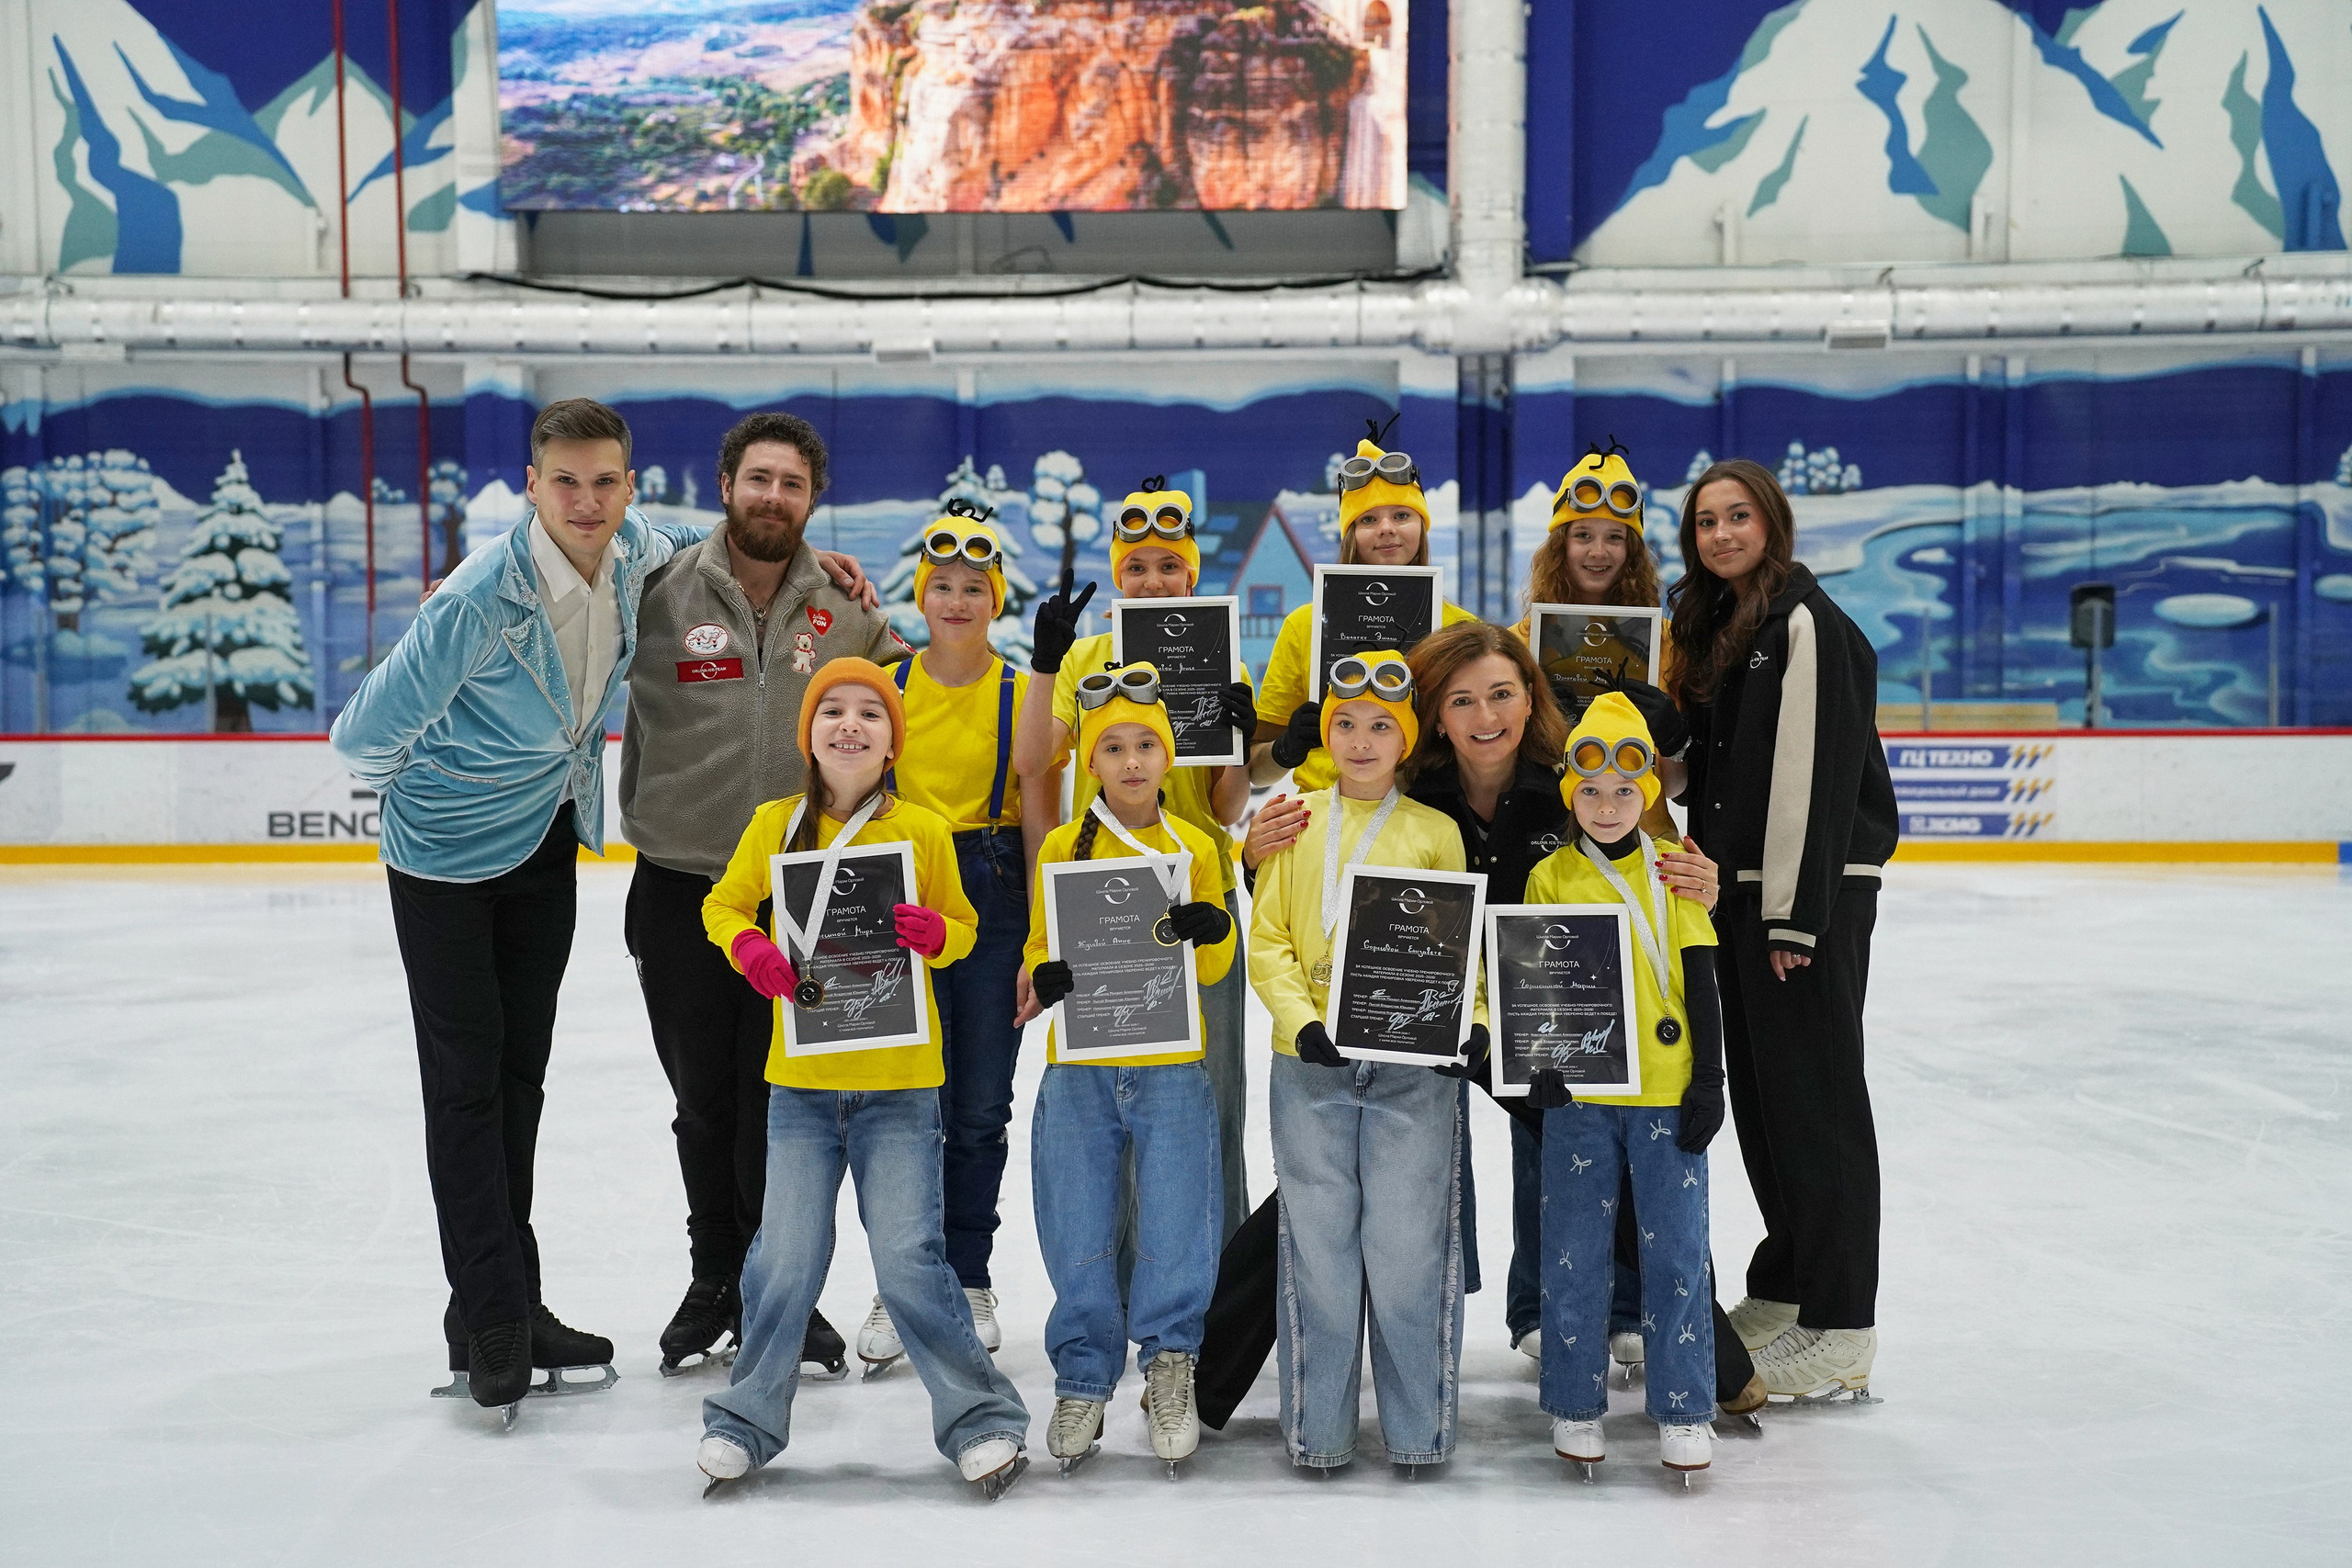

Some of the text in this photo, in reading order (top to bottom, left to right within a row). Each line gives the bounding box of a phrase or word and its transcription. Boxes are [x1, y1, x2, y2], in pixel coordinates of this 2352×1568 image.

[1576, 656, 1612, 664] ГРАМОТА
[1928, 749, 1995, 767] ТЕХНО
[826, 905, 866, 916] ГРАМОТА
[1099, 914, 1140, 925] ГРАМОТА
[1388, 923, 1430, 933] ГРАМОТА
